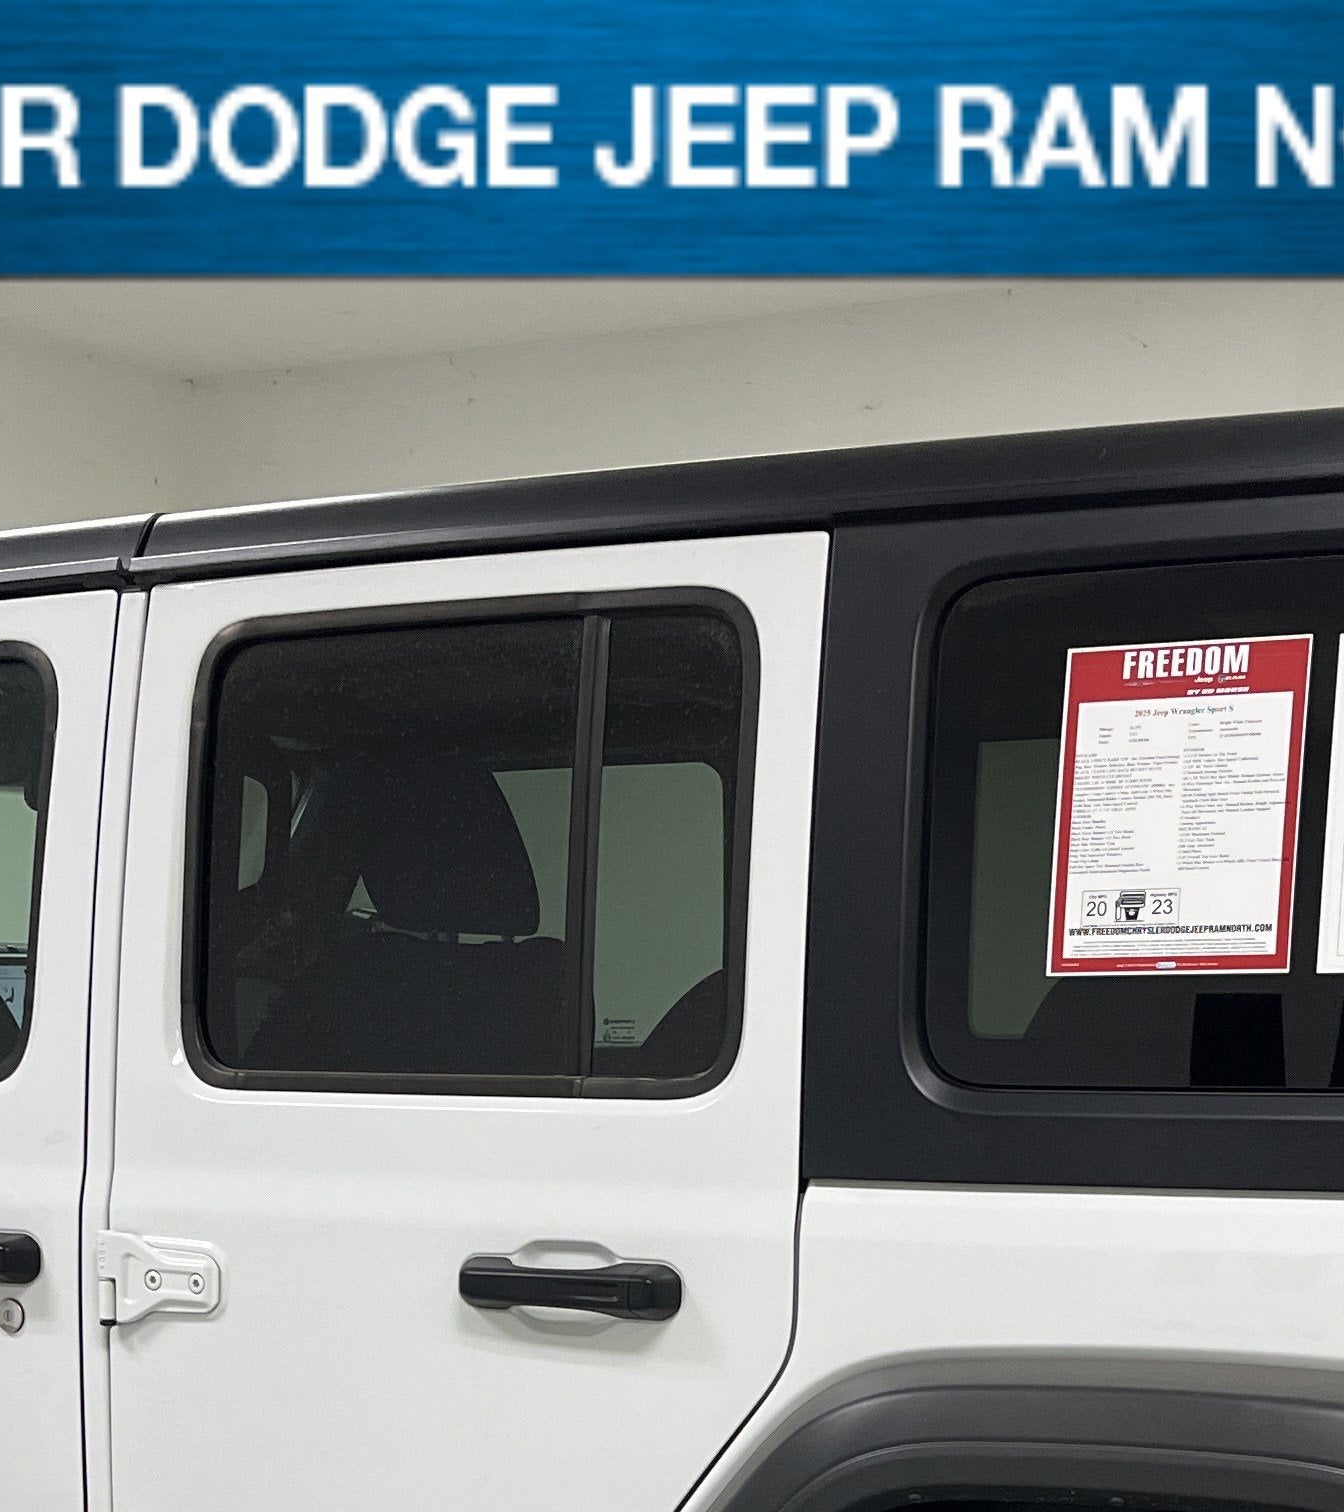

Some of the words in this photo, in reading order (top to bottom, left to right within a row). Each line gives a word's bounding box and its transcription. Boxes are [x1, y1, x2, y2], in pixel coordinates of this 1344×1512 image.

[1122, 644, 1250, 680] FREEDOM
[1152, 708, 1169, 717] Jeep
[1171, 707, 1205, 716] Wrangler
[1086, 901, 1108, 917] 20
[1151, 899, 1174, 915] 23
